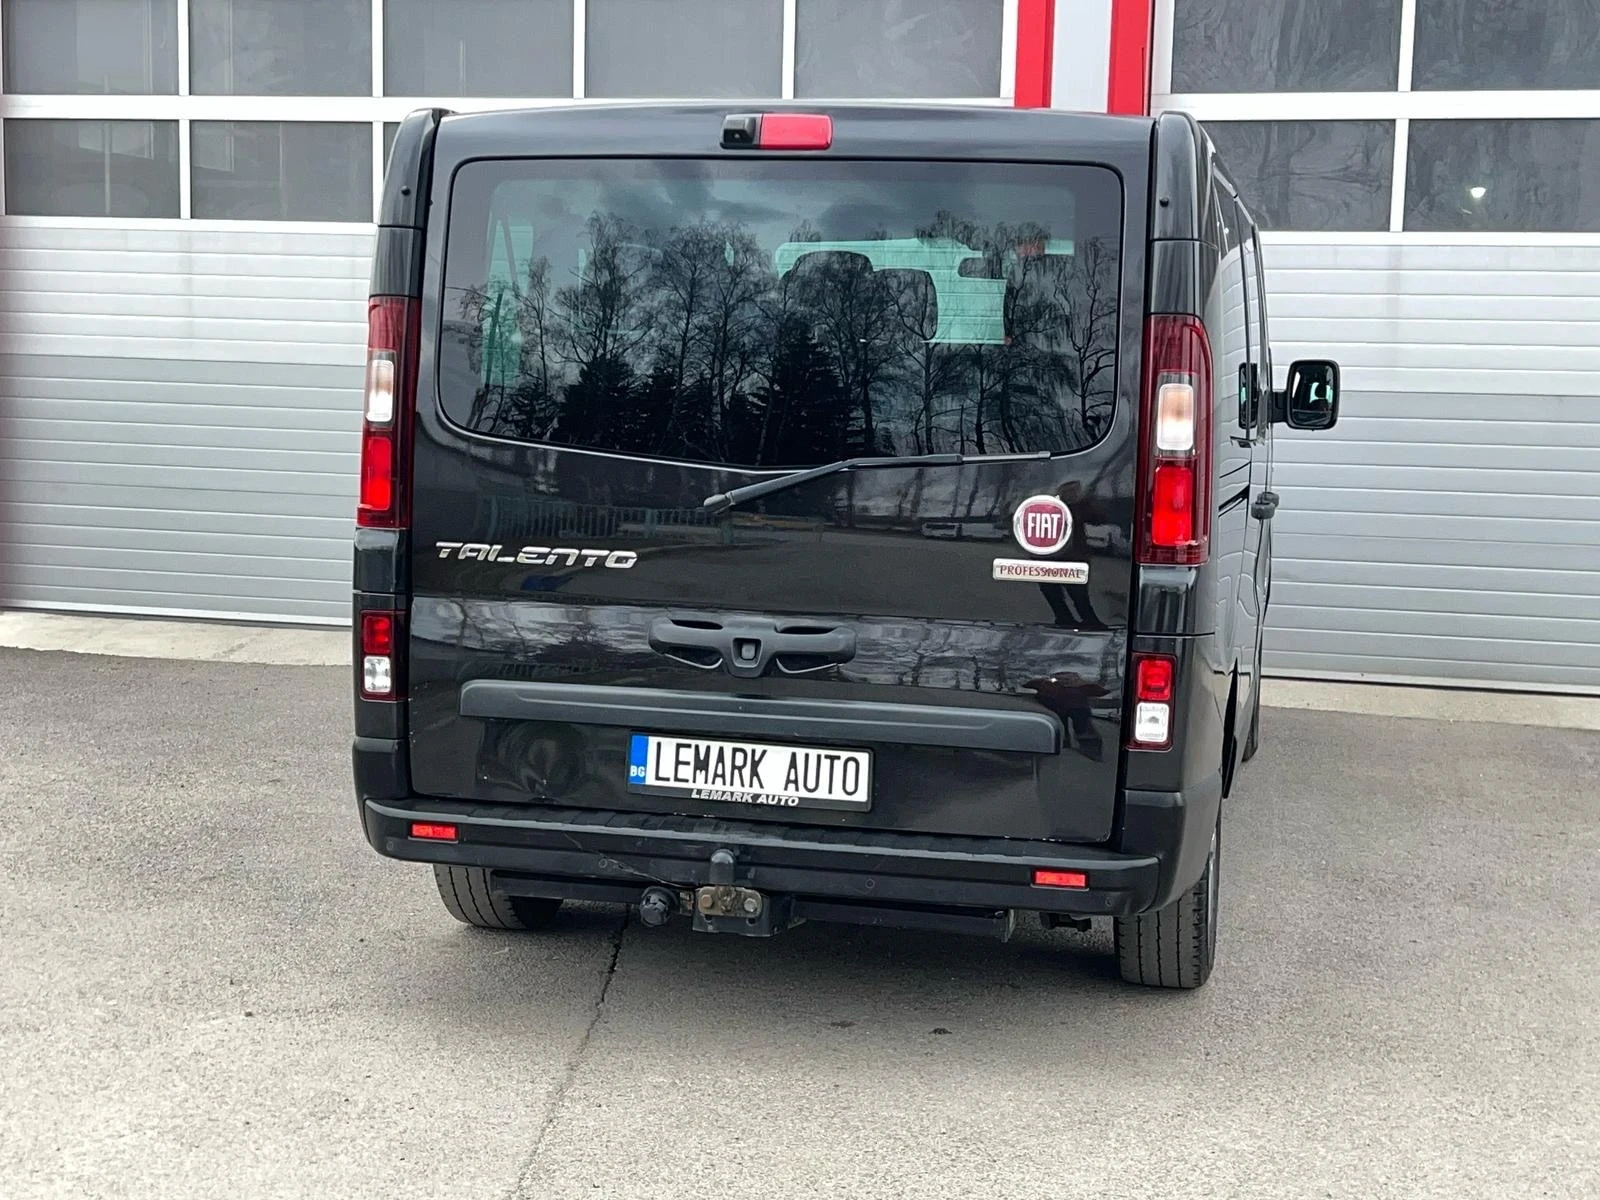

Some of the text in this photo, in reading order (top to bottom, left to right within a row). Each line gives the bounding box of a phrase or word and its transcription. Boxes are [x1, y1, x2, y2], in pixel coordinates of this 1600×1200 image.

[1027, 512, 1061, 539] FIAT
[436, 541, 638, 569] TALENTO
[1000, 564, 1085, 579] PROFESSIONAL
[629, 765, 646, 777] BG
[654, 741, 861, 796] LEMARK AUTO
[691, 788, 800, 807] LEMARK AUTO
